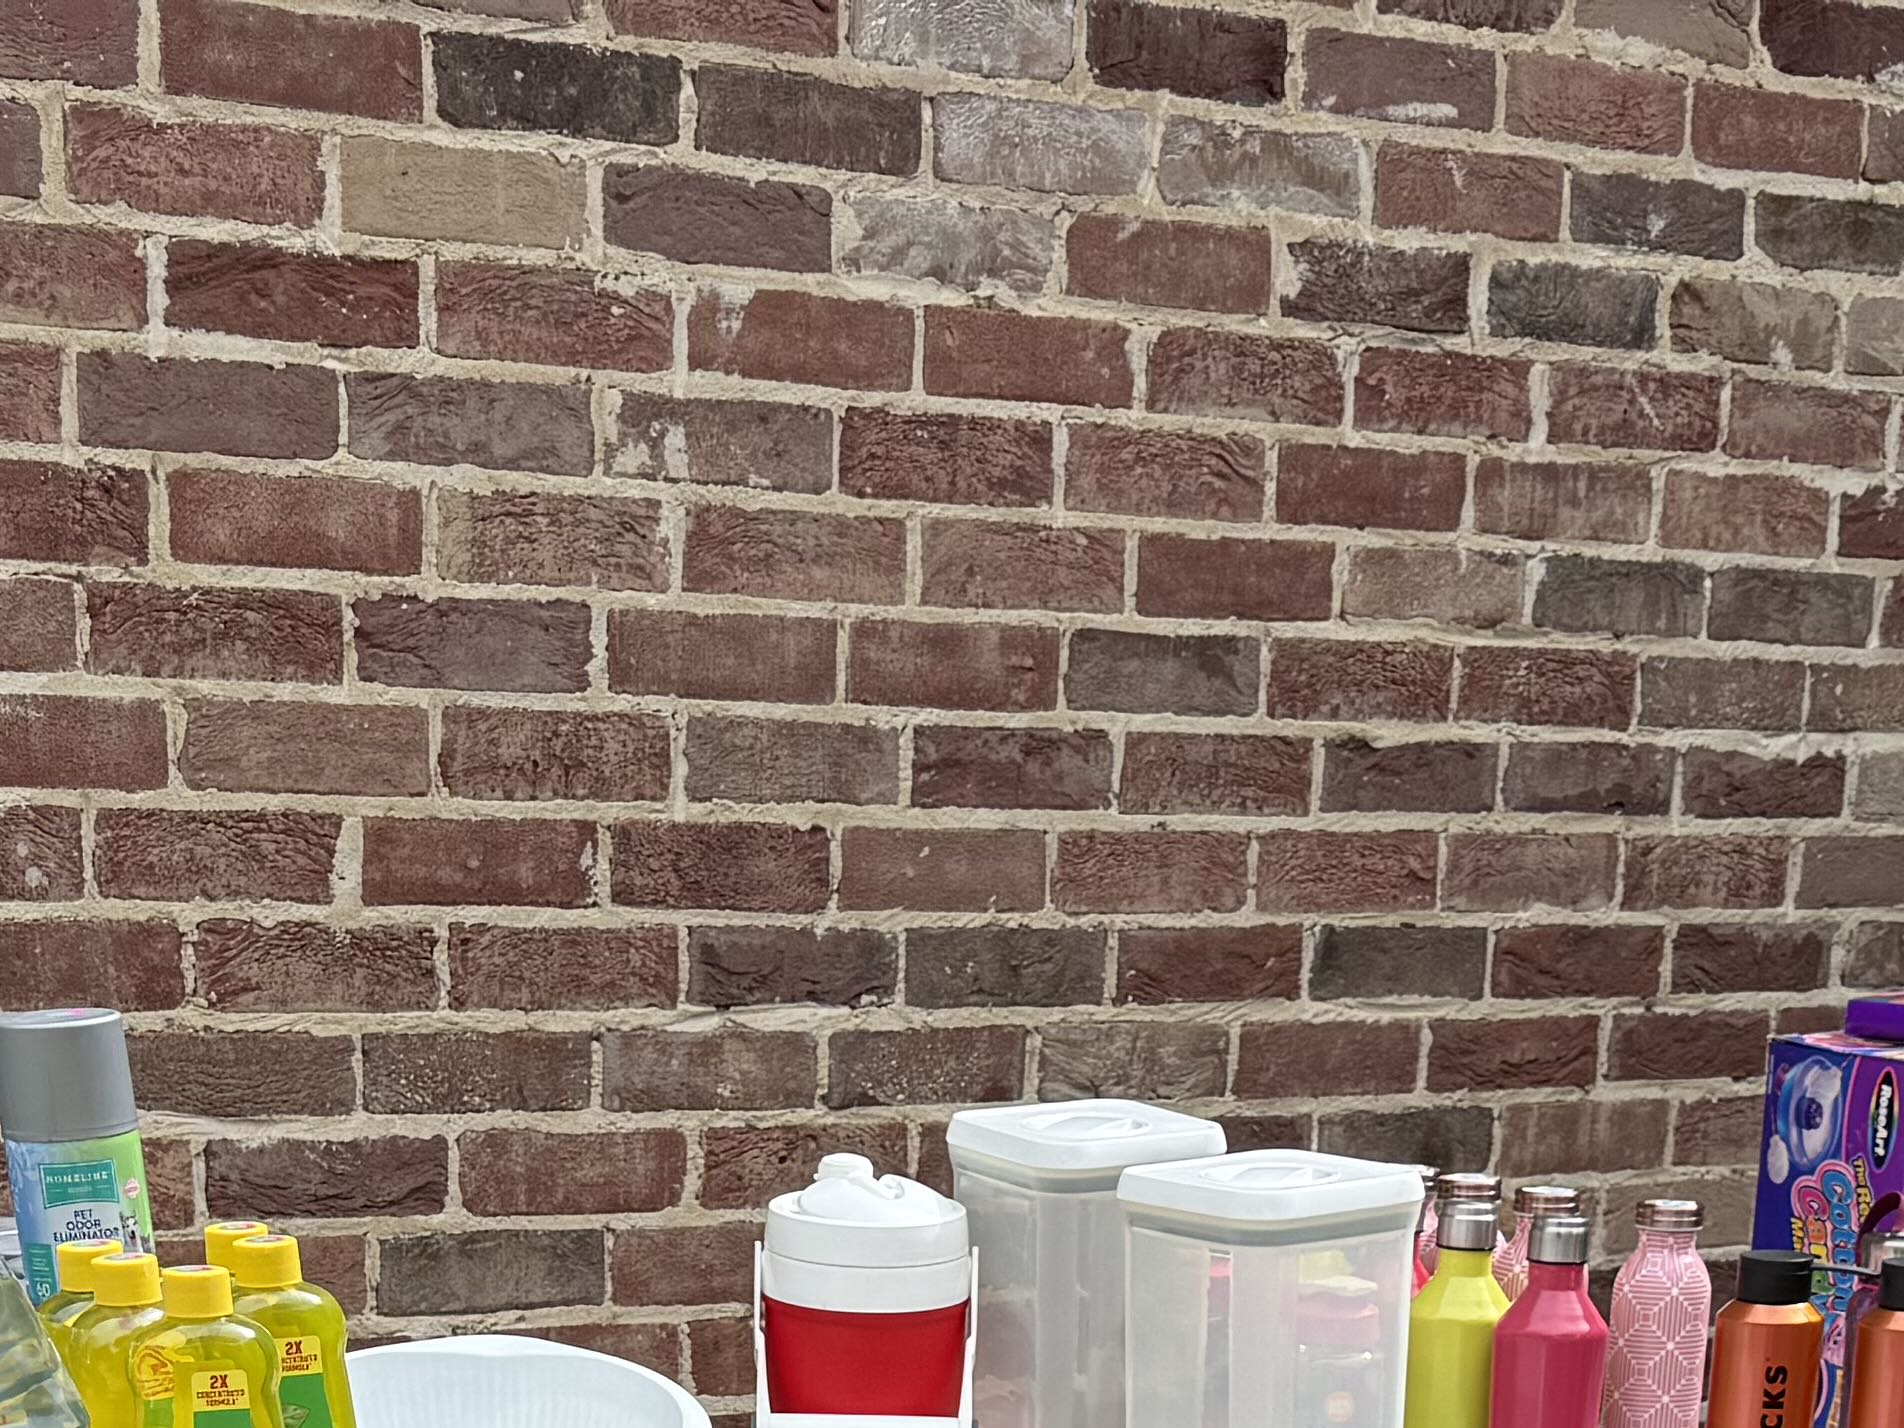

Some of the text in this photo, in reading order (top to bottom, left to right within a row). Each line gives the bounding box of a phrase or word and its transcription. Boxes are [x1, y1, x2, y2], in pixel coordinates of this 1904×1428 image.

[1874, 1084, 1893, 1157] RoseArt
[73, 1208, 94, 1220] PET
[66, 1219, 102, 1231] ODOR
[209, 1374, 229, 1389] 2X
